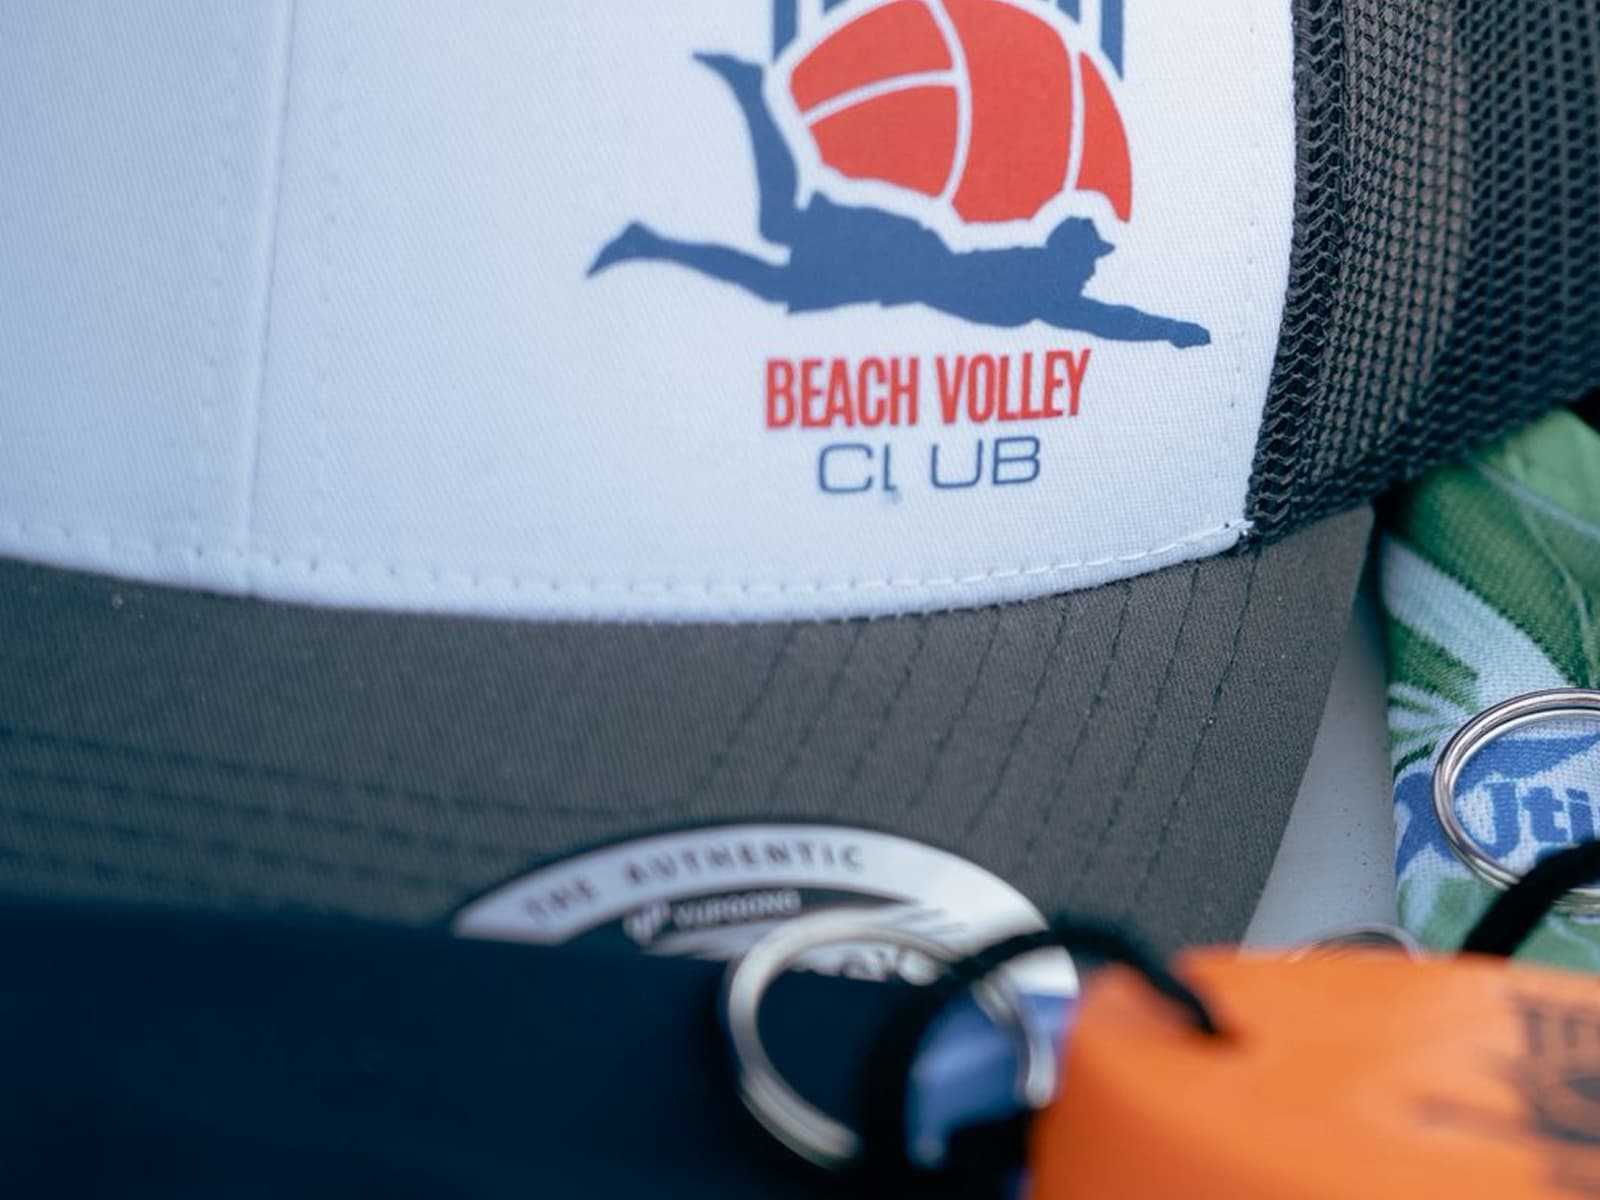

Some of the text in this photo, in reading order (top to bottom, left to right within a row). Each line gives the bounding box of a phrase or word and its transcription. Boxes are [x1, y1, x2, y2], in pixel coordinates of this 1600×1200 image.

[766, 349, 1091, 431] BEACH VOLLEY
[523, 842, 864, 922] THE AUTHENTIC
